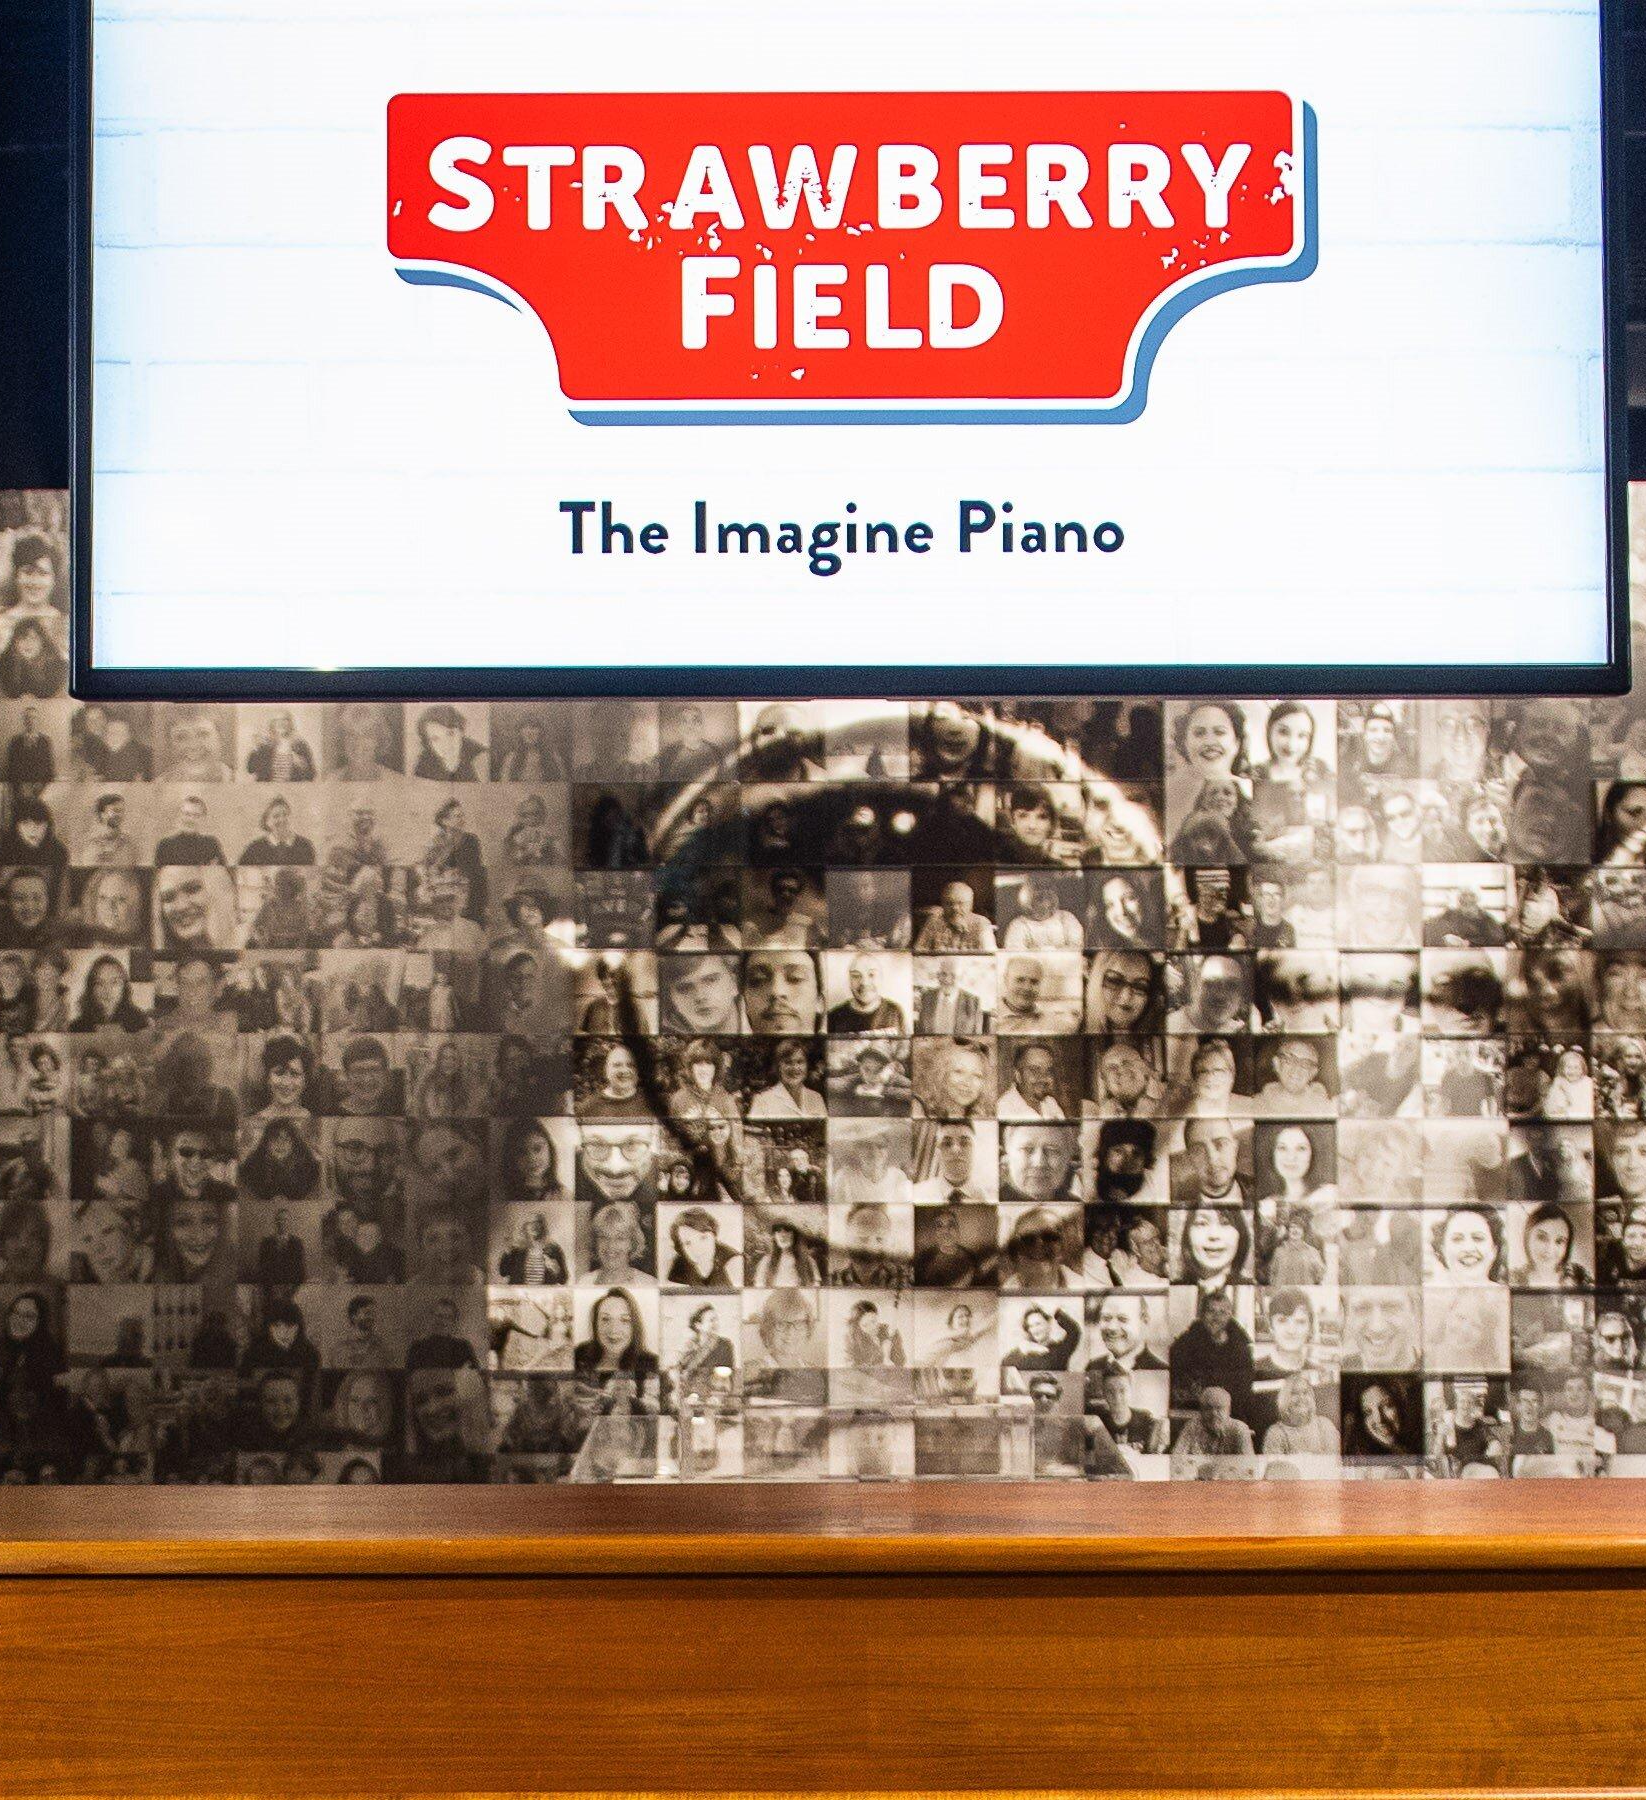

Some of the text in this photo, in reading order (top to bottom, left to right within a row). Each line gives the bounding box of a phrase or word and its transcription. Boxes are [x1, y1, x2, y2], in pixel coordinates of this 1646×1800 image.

[427, 136, 1252, 232] STRAWBERRY
[681, 256, 1004, 350] FIELD
[558, 499, 1125, 577] The Imagine Piano
